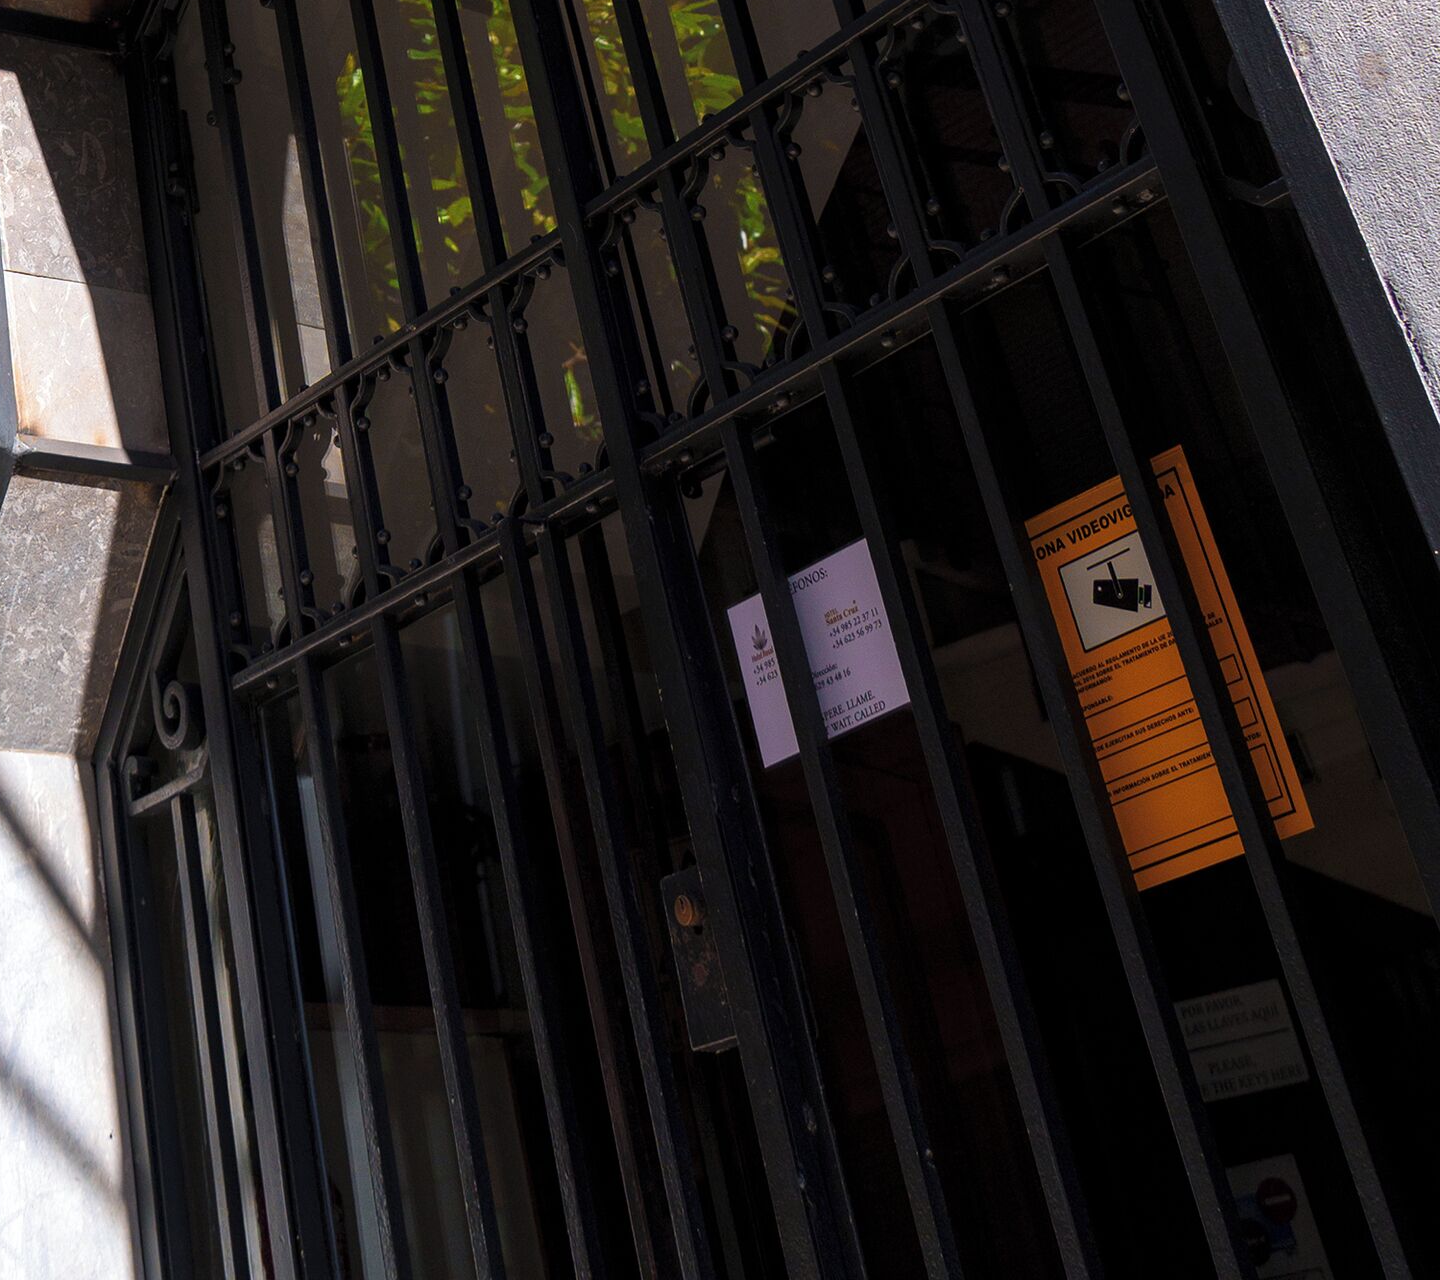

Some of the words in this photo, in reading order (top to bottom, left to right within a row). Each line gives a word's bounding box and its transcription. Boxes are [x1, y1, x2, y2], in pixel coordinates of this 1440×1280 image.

[1034, 537, 1066, 561] ONA
[825, 613, 843, 626] Santa
[843, 605, 859, 618] Cruz
[841, 619, 852, 632] 985
[853, 615, 861, 627] 22
[862, 611, 870, 622] 37
[870, 607, 879, 618] 11
[844, 632, 855, 644] 623
[856, 627, 865, 638] 56
[864, 623, 873, 634] 99
[1105, 645, 1141, 665] REGLAMENTO
[1141, 640, 1150, 649] DE
[1150, 638, 1157, 646] LA
[1121, 645, 1160, 666] TRATAMIENTO
[854, 700, 886, 722] CALLED
[1147, 715, 1177, 731] DERECHOS
